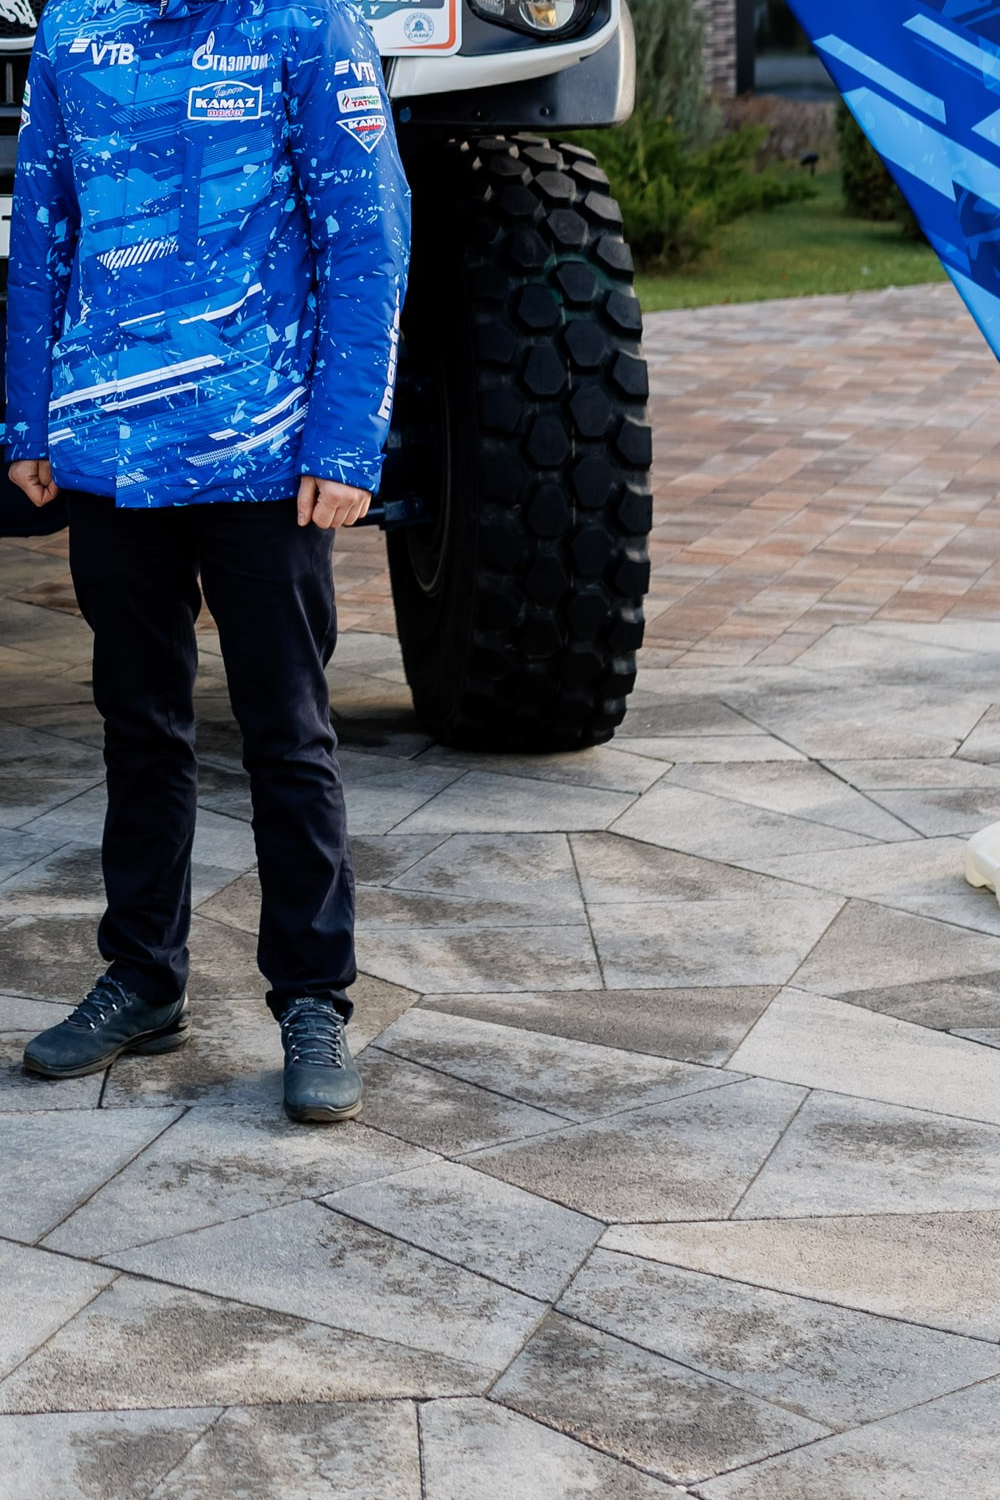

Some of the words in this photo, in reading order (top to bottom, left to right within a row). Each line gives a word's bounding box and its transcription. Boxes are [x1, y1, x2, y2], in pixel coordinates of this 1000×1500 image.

[91, 42, 135, 66] VTB
[350, 61, 376, 82] VTB
[195, 97, 256, 109] KAMAZ
[295, 996, 315, 1005] ecco
